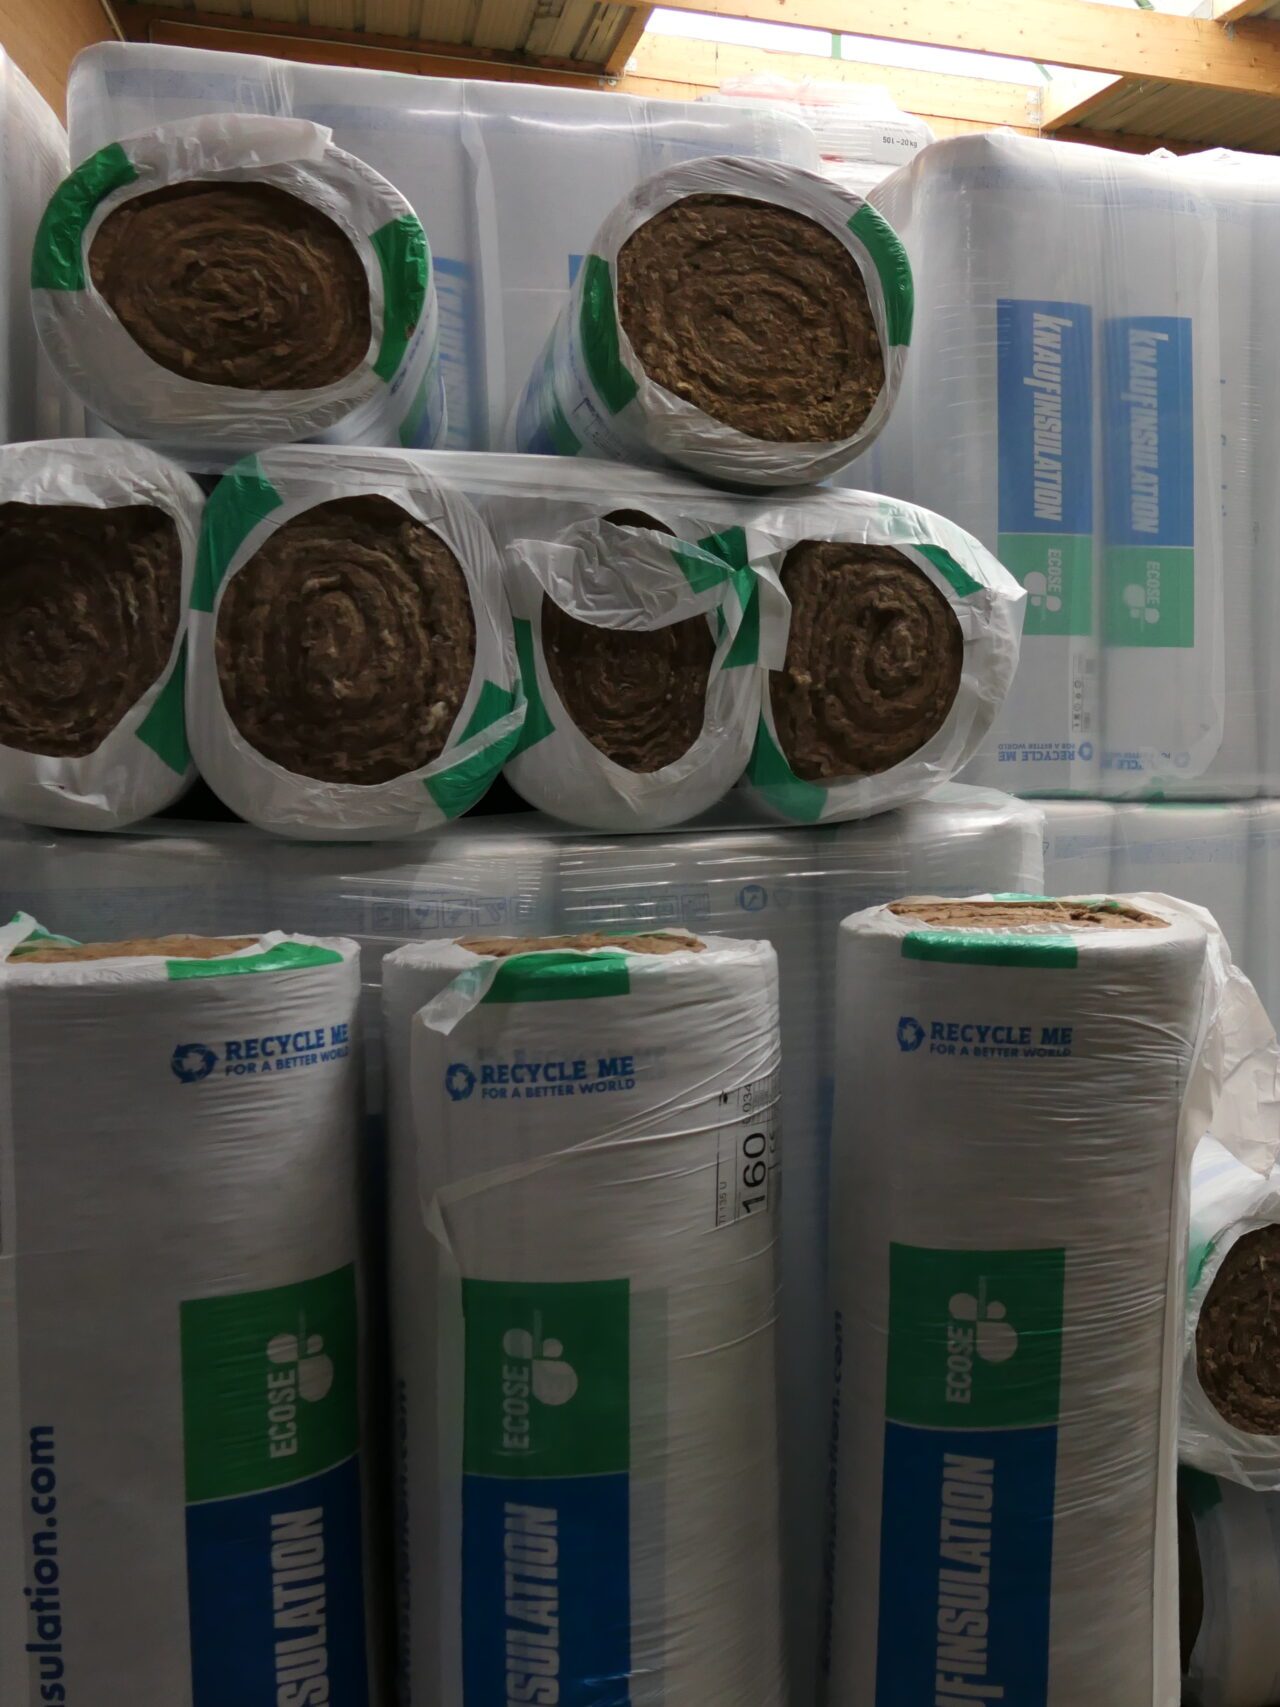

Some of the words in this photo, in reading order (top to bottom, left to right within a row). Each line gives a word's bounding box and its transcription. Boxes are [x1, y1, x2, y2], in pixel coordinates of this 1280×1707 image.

[1047, 548, 1062, 592] ECOSE
[998, 751, 1016, 762] ME
[1021, 750, 1076, 762] RECYCLE
[224, 1029, 325, 1061] RECYCLE
[331, 1023, 349, 1046] ME
[930, 1021, 1032, 1045] RECYCLE
[1040, 1027, 1073, 1046] ME
[226, 1061, 256, 1076] FOR
[261, 1060, 272, 1072] A
[276, 1053, 317, 1070] BETTER
[929, 1043, 956, 1056] FOR
[960, 1046, 970, 1056] A
[973, 1046, 1018, 1058] BETTER
[1023, 1047, 1072, 1058] WORLD
[481, 1060, 587, 1084] RECYCLE
[597, 1056, 635, 1078] ME
[482, 1087, 507, 1099] FOR
[511, 1086, 521, 1098] A
[525, 1084, 574, 1098] BETTER
[579, 1078, 636, 1094] WORLD
[742, 1132, 766, 1213] 160
[945, 1326, 974, 1404] ECOSE
[267, 1367, 298, 1459] ECOSE
[502, 1365, 530, 1449] ECOSE
[23, 1424, 66, 1707] sulation.com
